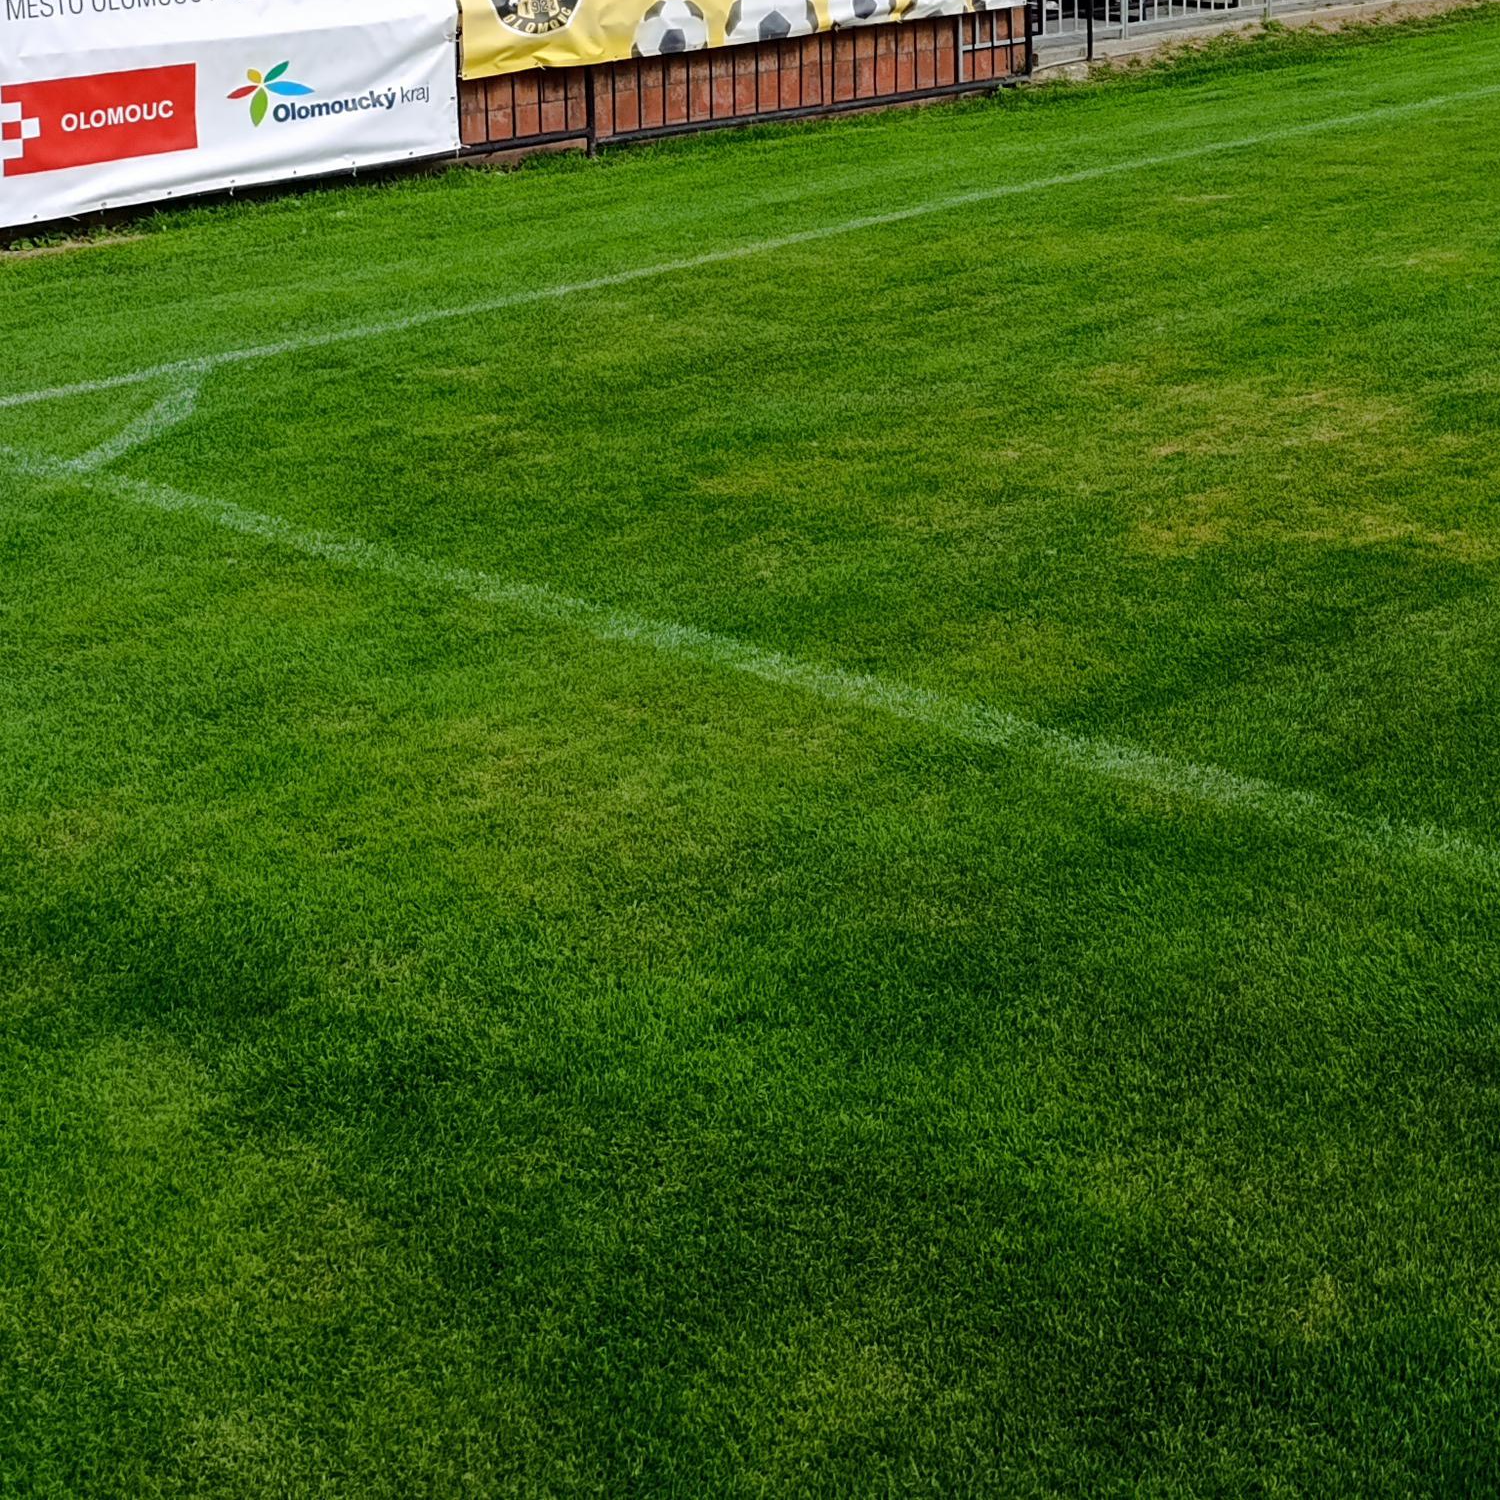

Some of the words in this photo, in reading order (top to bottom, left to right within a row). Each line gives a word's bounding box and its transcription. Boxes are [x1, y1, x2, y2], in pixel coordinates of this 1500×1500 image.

[502, 6, 572, 34] OLOMOUC
[61, 100, 174, 132] OLOMOUC
[273, 87, 396, 123] Olomoucký
[400, 82, 430, 104] kraj
